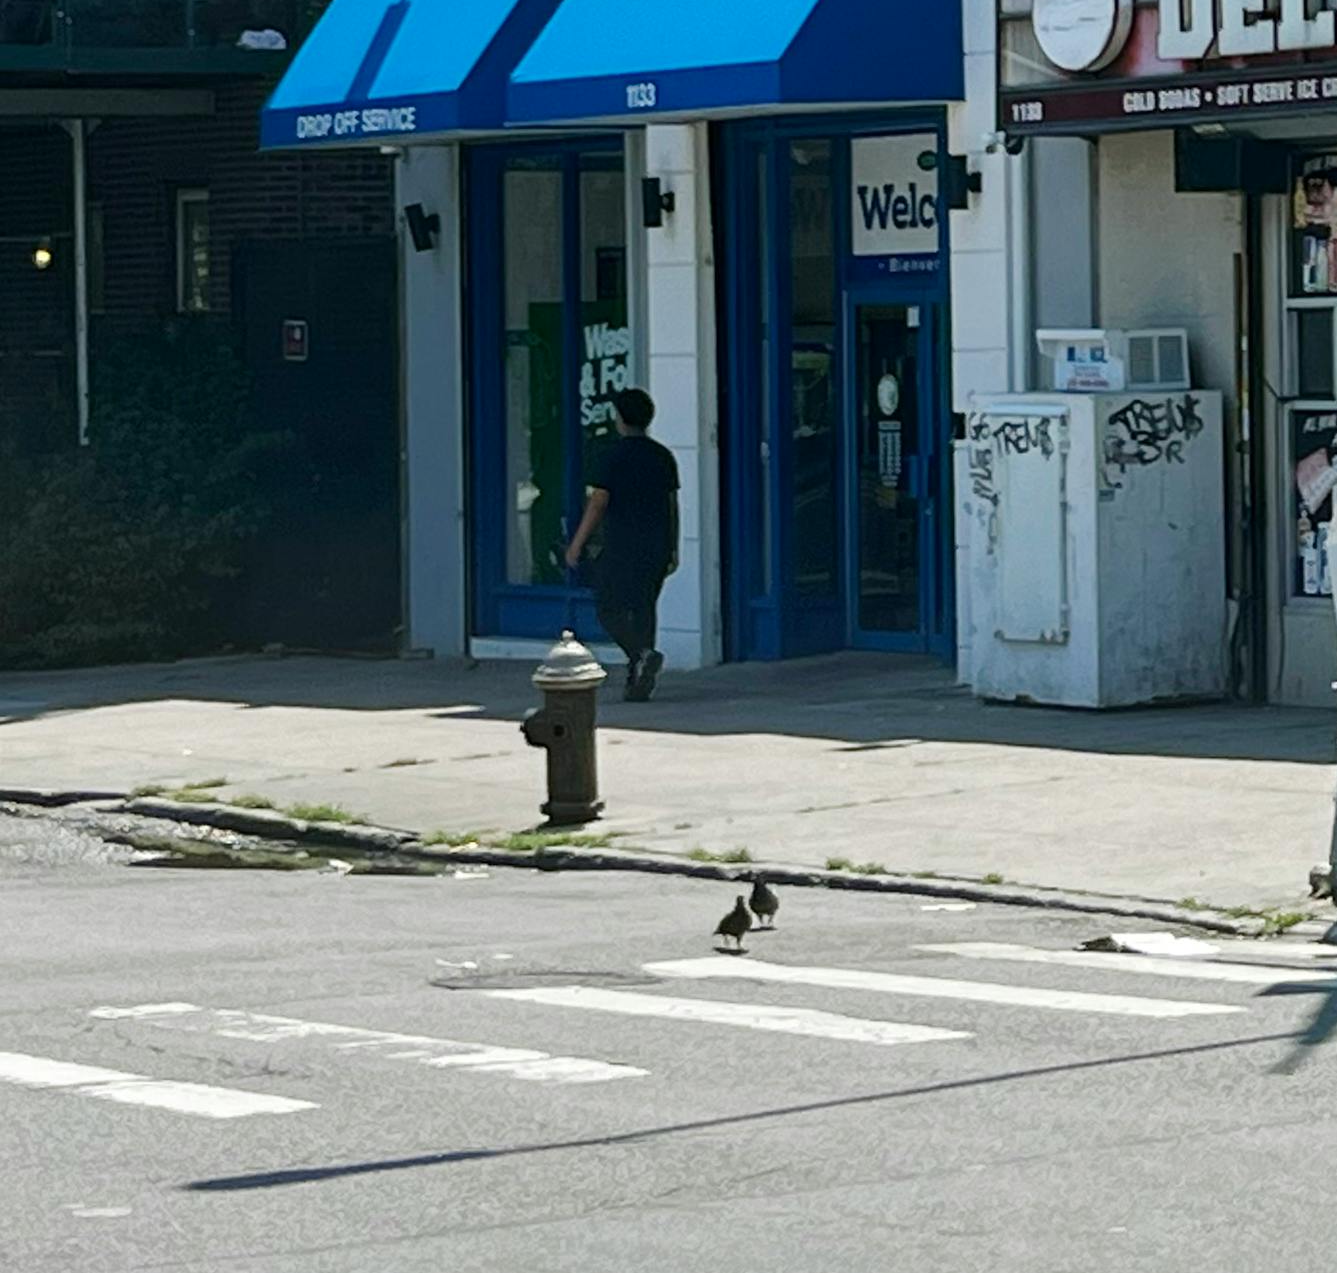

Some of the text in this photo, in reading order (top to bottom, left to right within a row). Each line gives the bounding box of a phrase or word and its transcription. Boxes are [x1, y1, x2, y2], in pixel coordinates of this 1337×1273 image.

[1122, 90, 1155, 113] COLD
[1159, 87, 1201, 110] SODAS
[1216, 84, 1250, 106] SOFT
[1252, 80, 1294, 104] SERVE
[1296, 78, 1320, 100] ICE
[296, 107, 417, 139] DROP OFF SERVICE
[857, 182, 940, 231] Welc
